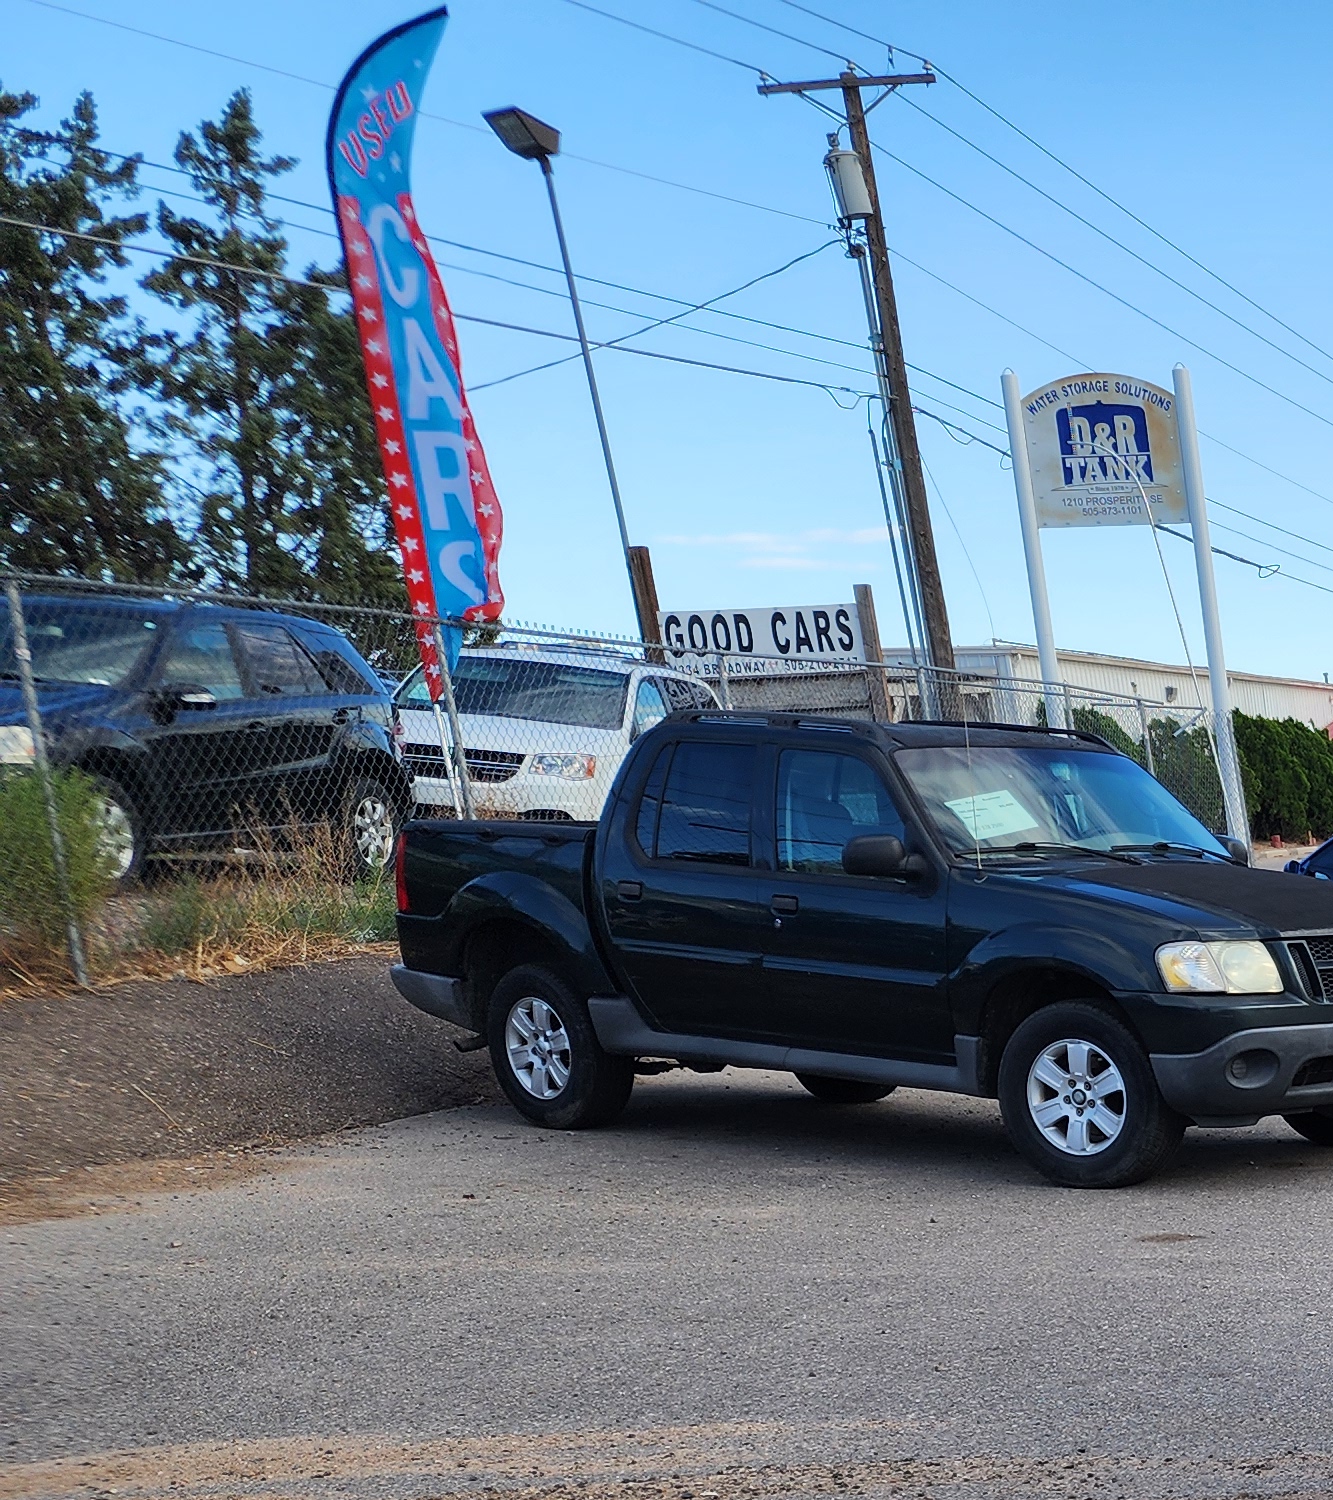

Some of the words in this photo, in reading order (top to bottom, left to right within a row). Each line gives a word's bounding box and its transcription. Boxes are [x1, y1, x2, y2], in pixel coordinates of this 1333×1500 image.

[367, 206, 484, 606] CARS
[1026, 390, 1060, 415] WATER
[1062, 380, 1108, 397] STORAGE
[1115, 382, 1171, 411] SOLUTIONS
[1073, 415, 1139, 456] D&R
[1066, 457, 1148, 485] TANK
[1062, 498, 1083, 506] 1210
[1150, 494, 1163, 503] SE
[1082, 505, 1142, 517] 505-873-1101
[665, 614, 753, 658] GOOD
[771, 609, 853, 654] CARS
[703, 661, 767, 675] BRADWAY
